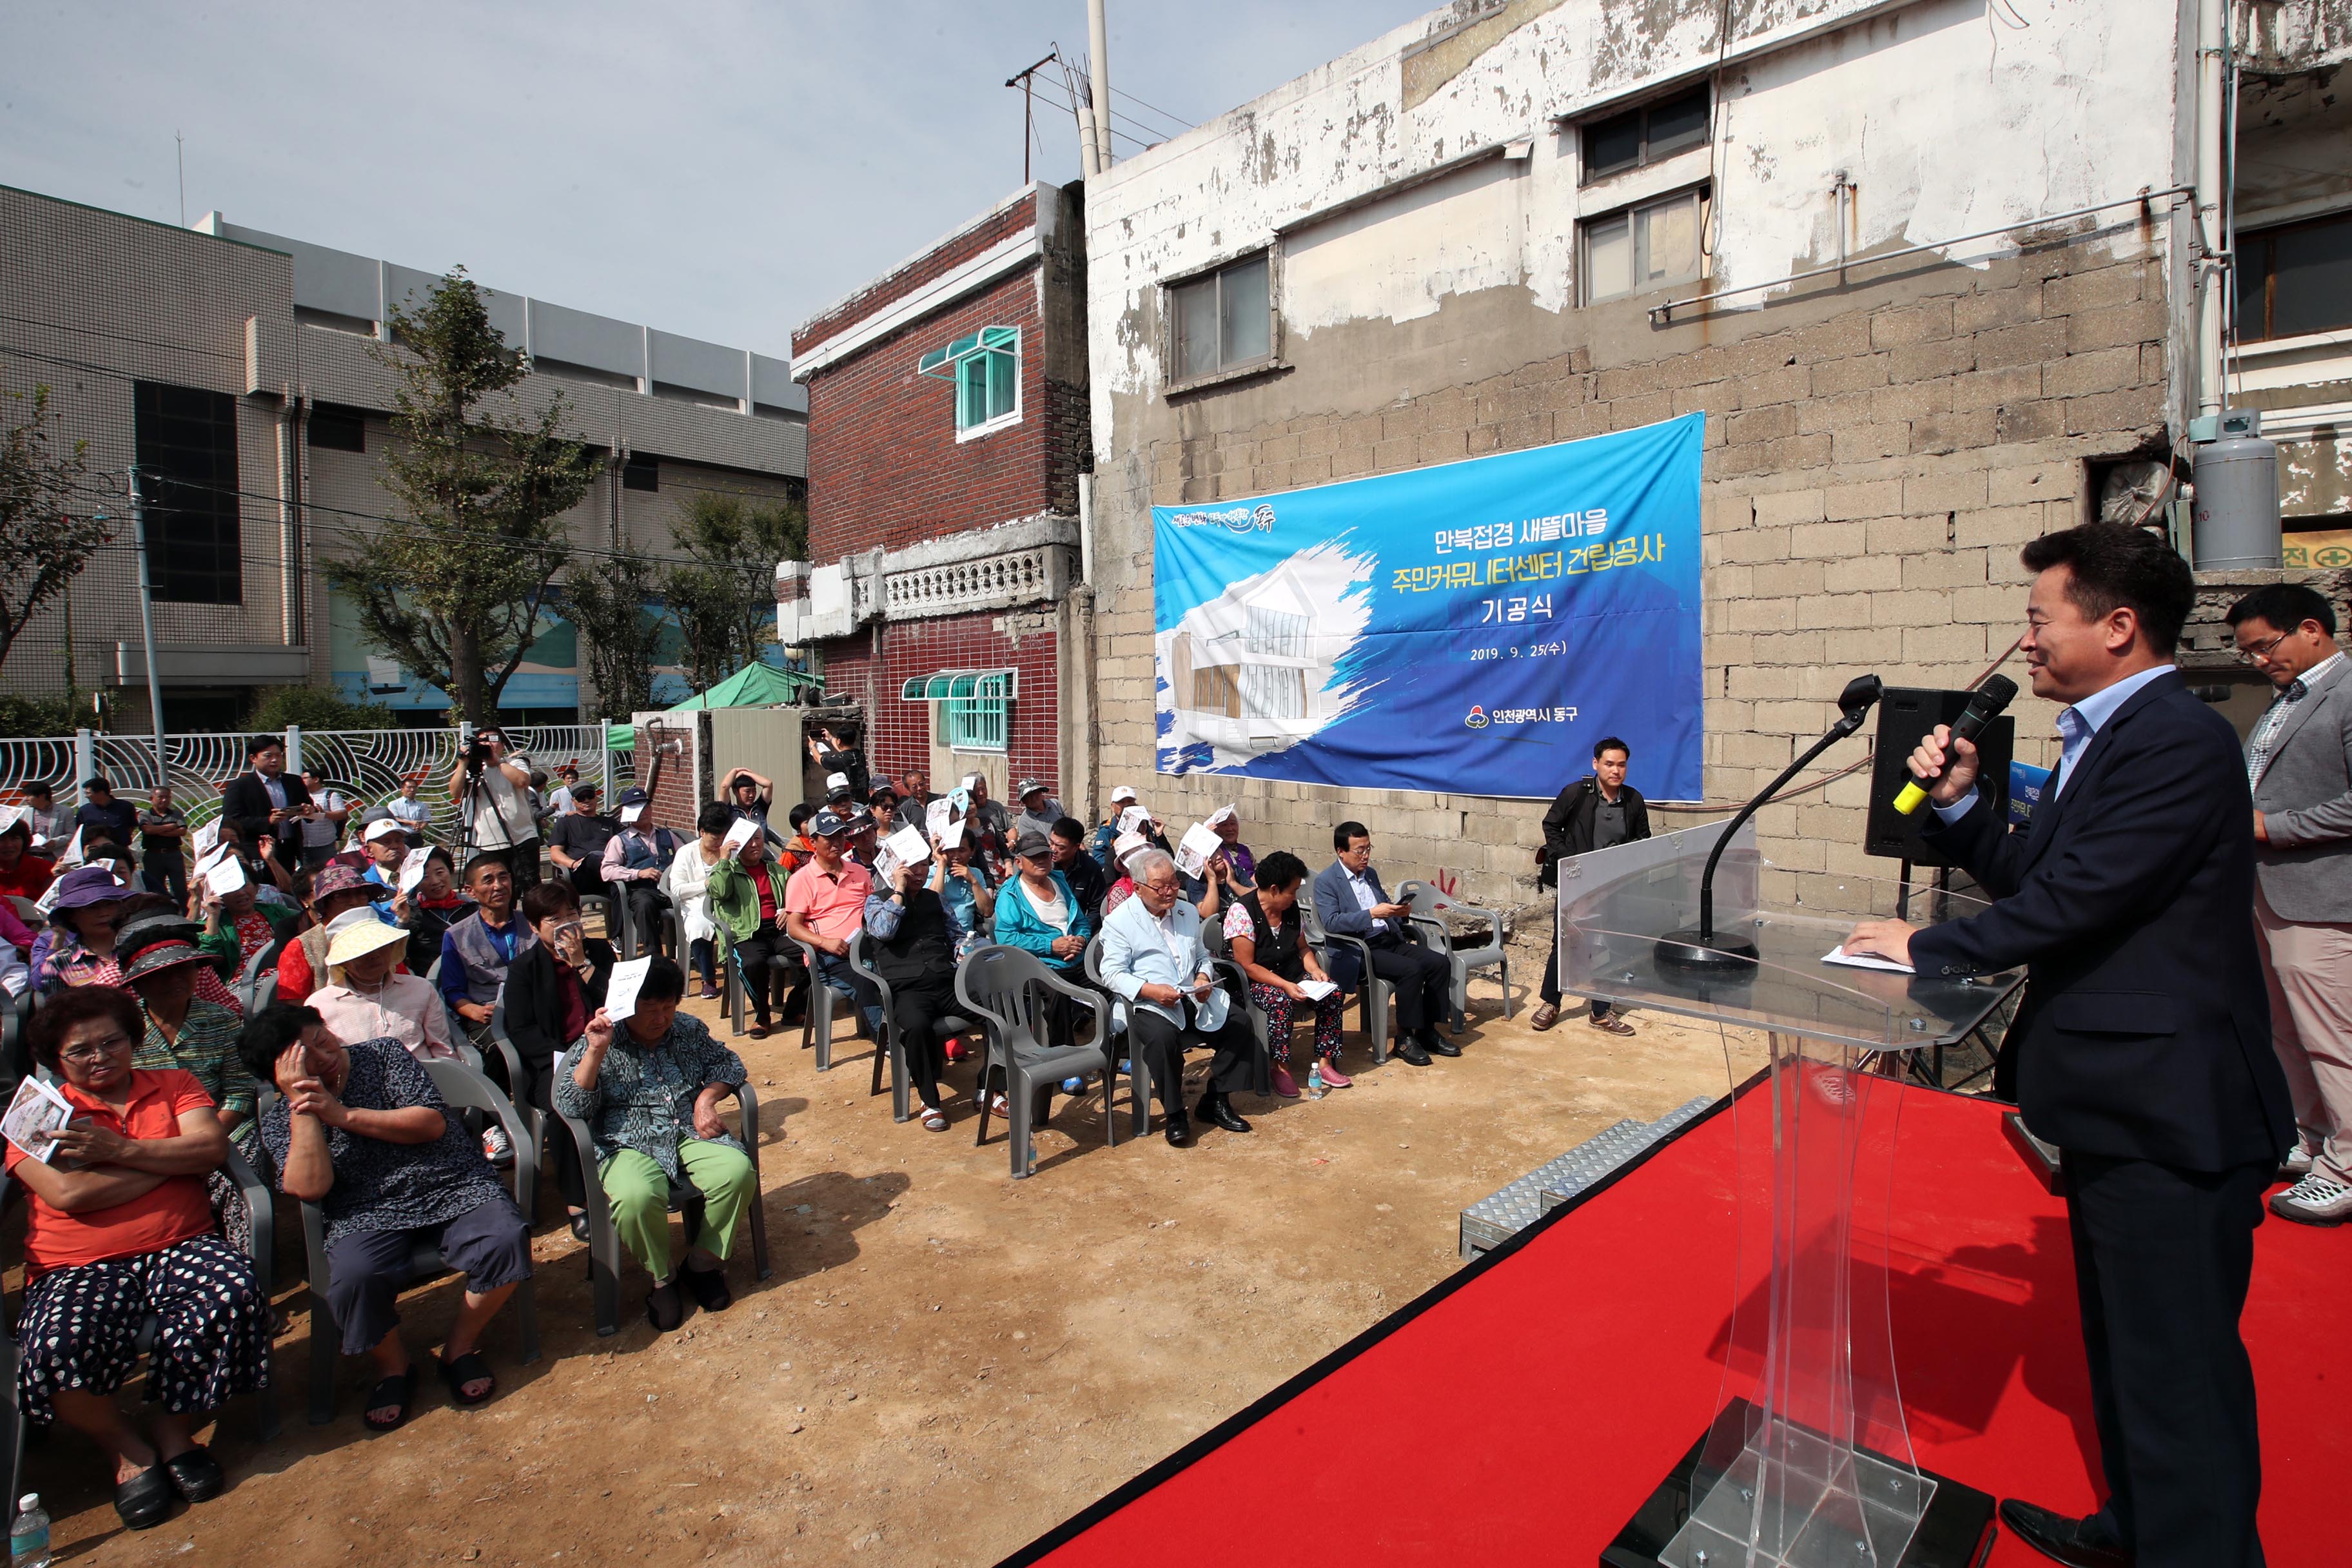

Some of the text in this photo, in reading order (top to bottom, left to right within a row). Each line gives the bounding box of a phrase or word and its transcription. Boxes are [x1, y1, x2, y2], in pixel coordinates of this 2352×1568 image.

[1254, 504, 1276, 533] 동구
[1435, 508, 1608, 554] 만북접경 새뜰마을
[1391, 533, 1666, 593] 주민커뮤니터센터 건립공사
[1482, 593, 1553, 623] 기공식
[1470, 640, 1567, 661] 2019. 9. 25(수)
[1493, 707, 1578, 723] 인천광역시 동구
